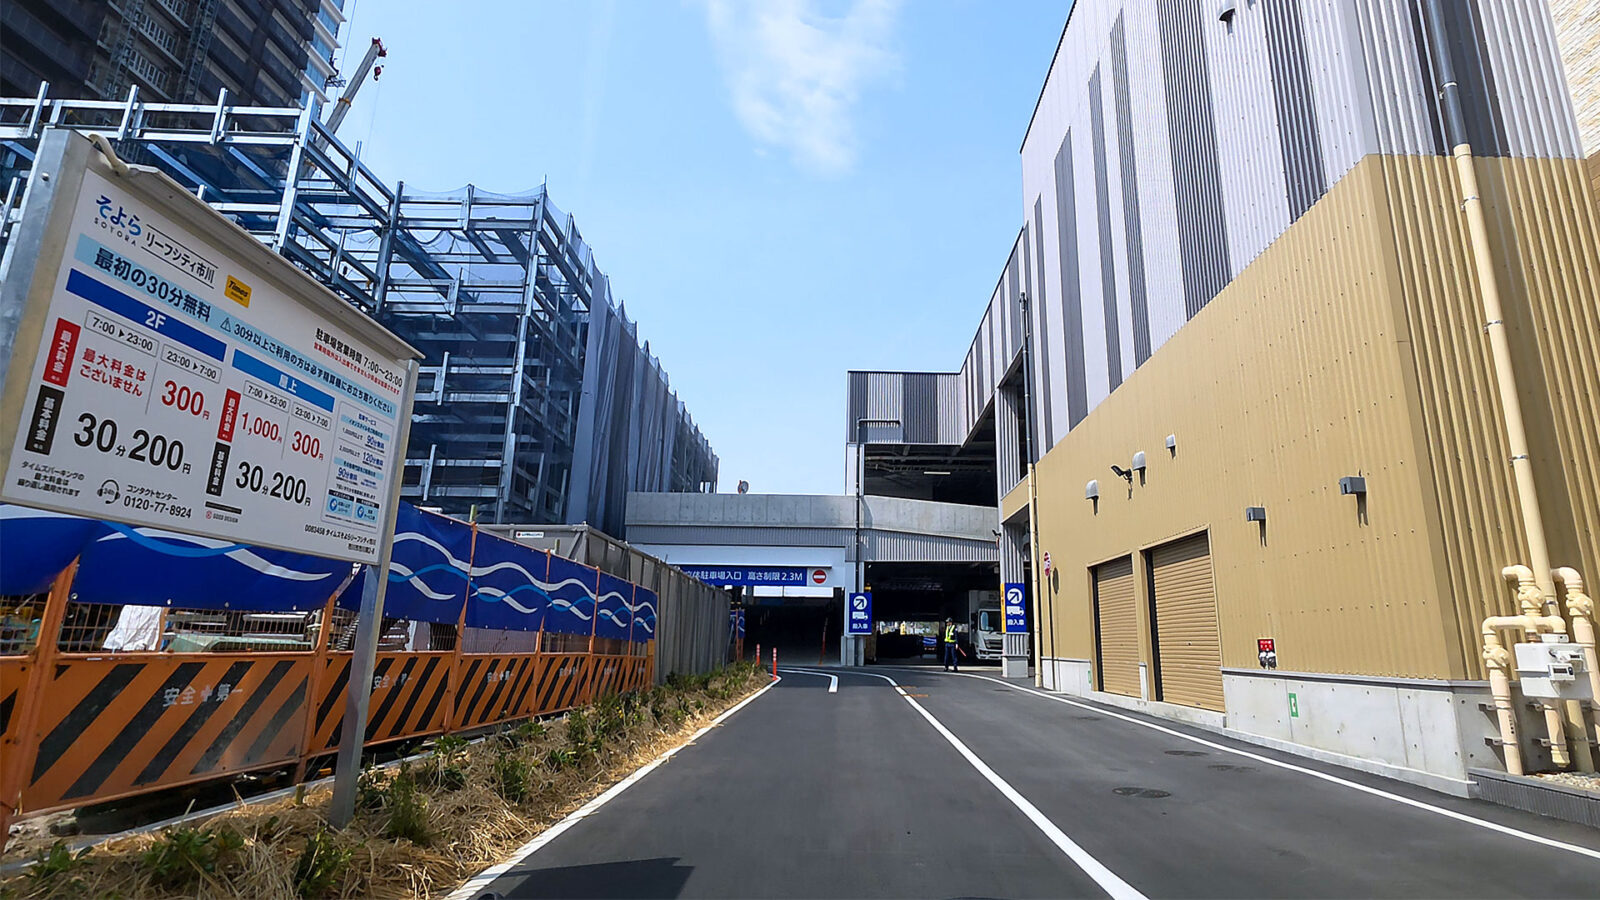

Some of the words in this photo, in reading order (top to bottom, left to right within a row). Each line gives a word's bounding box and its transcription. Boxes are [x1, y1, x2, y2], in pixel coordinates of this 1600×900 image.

[95, 195, 142, 237] そよら
[93, 217, 138, 247] SOYORA
[146, 231, 215, 285] リーフシティ市川
[94, 247, 213, 323] 最初の30分無料
[92, 316, 116, 336] 7:00
[126, 332, 154, 352] 23:00
[145, 310, 168, 330] 2F
[82, 347, 147, 382] 最大料金は
[167, 350, 191, 369] 23:00
[199, 362, 217, 381] 7:00
[79, 363, 144, 397] ございません
[248, 385, 263, 399] 7:00
[269, 394, 287, 410] 23:00
[295, 407, 311, 421] 23:00
[123, 495, 192, 519] 0120-77-8924
[126, 484, 179, 501] コンタクトセンター
[163, 686, 198, 707] 安全
